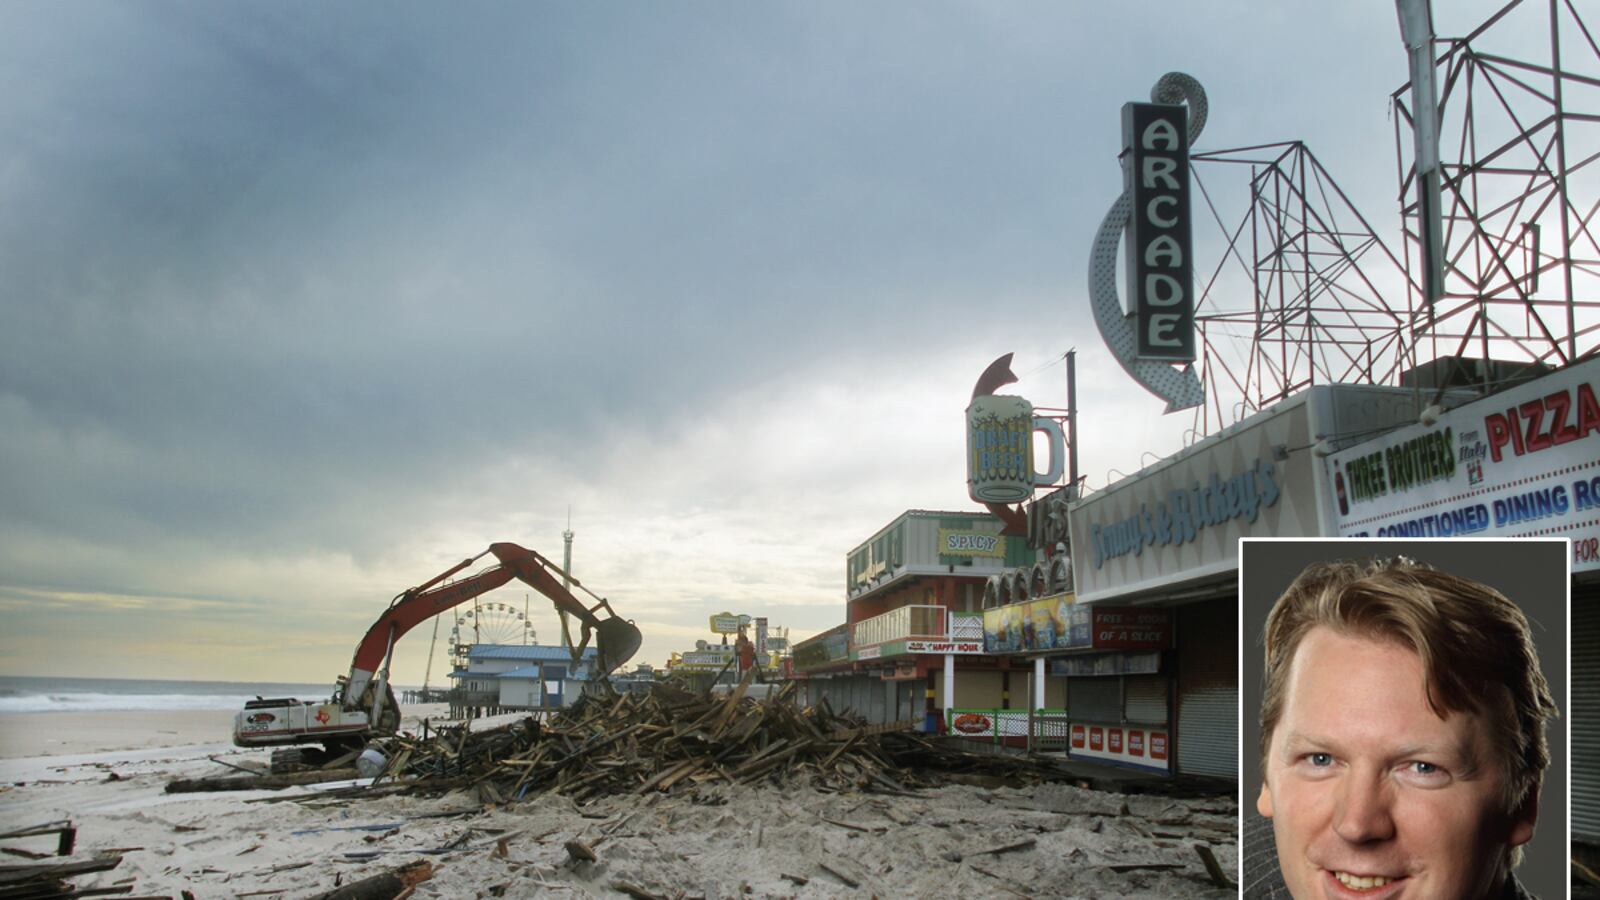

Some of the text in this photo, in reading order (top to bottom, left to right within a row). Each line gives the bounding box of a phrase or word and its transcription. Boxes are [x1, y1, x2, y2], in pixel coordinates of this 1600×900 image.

[1142, 118, 1183, 347] ARCADE
[1484, 382, 1600, 463] PIZZA
[976, 430, 1028, 449] DRAFT
[1459, 430, 1479, 444] From
[981, 451, 1025, 471] BEER
[1457, 440, 1487, 464] Italy
[1345, 426, 1456, 504] THREE BROTHERS
[1492, 485, 1569, 528] DINING
[946, 533, 999, 552] SPICY
[1573, 537, 1600, 564] FOR
[1096, 614, 1123, 624] FREE
[1099, 631, 1163, 641] OF A SLICE
[932, 643, 955, 652] HAPPY
[958, 643, 979, 652] HOUR
